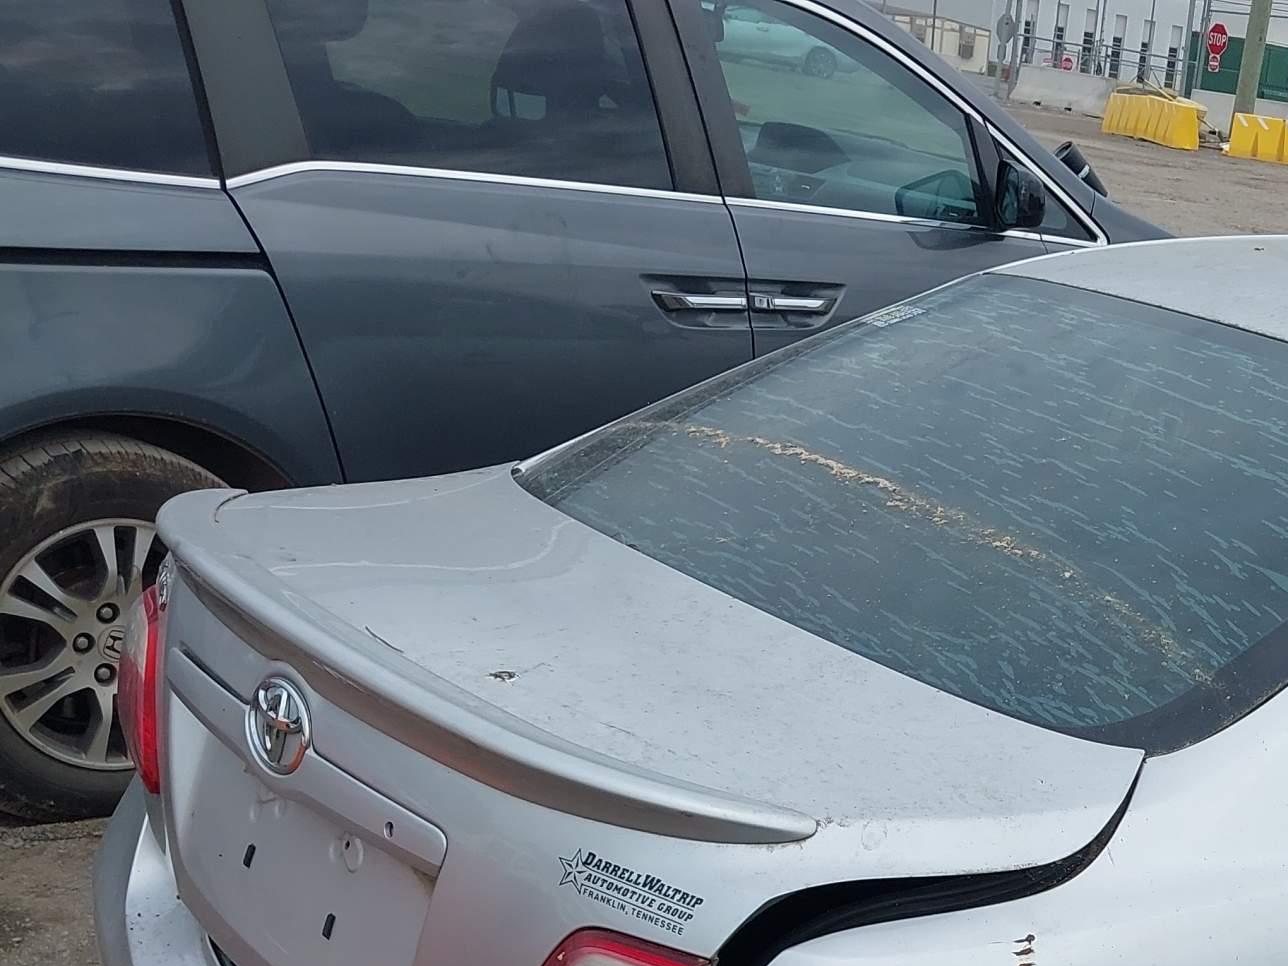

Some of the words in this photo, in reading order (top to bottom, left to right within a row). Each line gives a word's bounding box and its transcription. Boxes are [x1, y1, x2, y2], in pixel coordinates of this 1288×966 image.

[1209, 32, 1227, 47] STOP
[582, 887, 629, 916] FRANKLIN,
[631, 907, 684, 936] TENNESSEE
[583, 872, 657, 908] AUTOMOTIVE
[657, 901, 694, 922] GROUP
